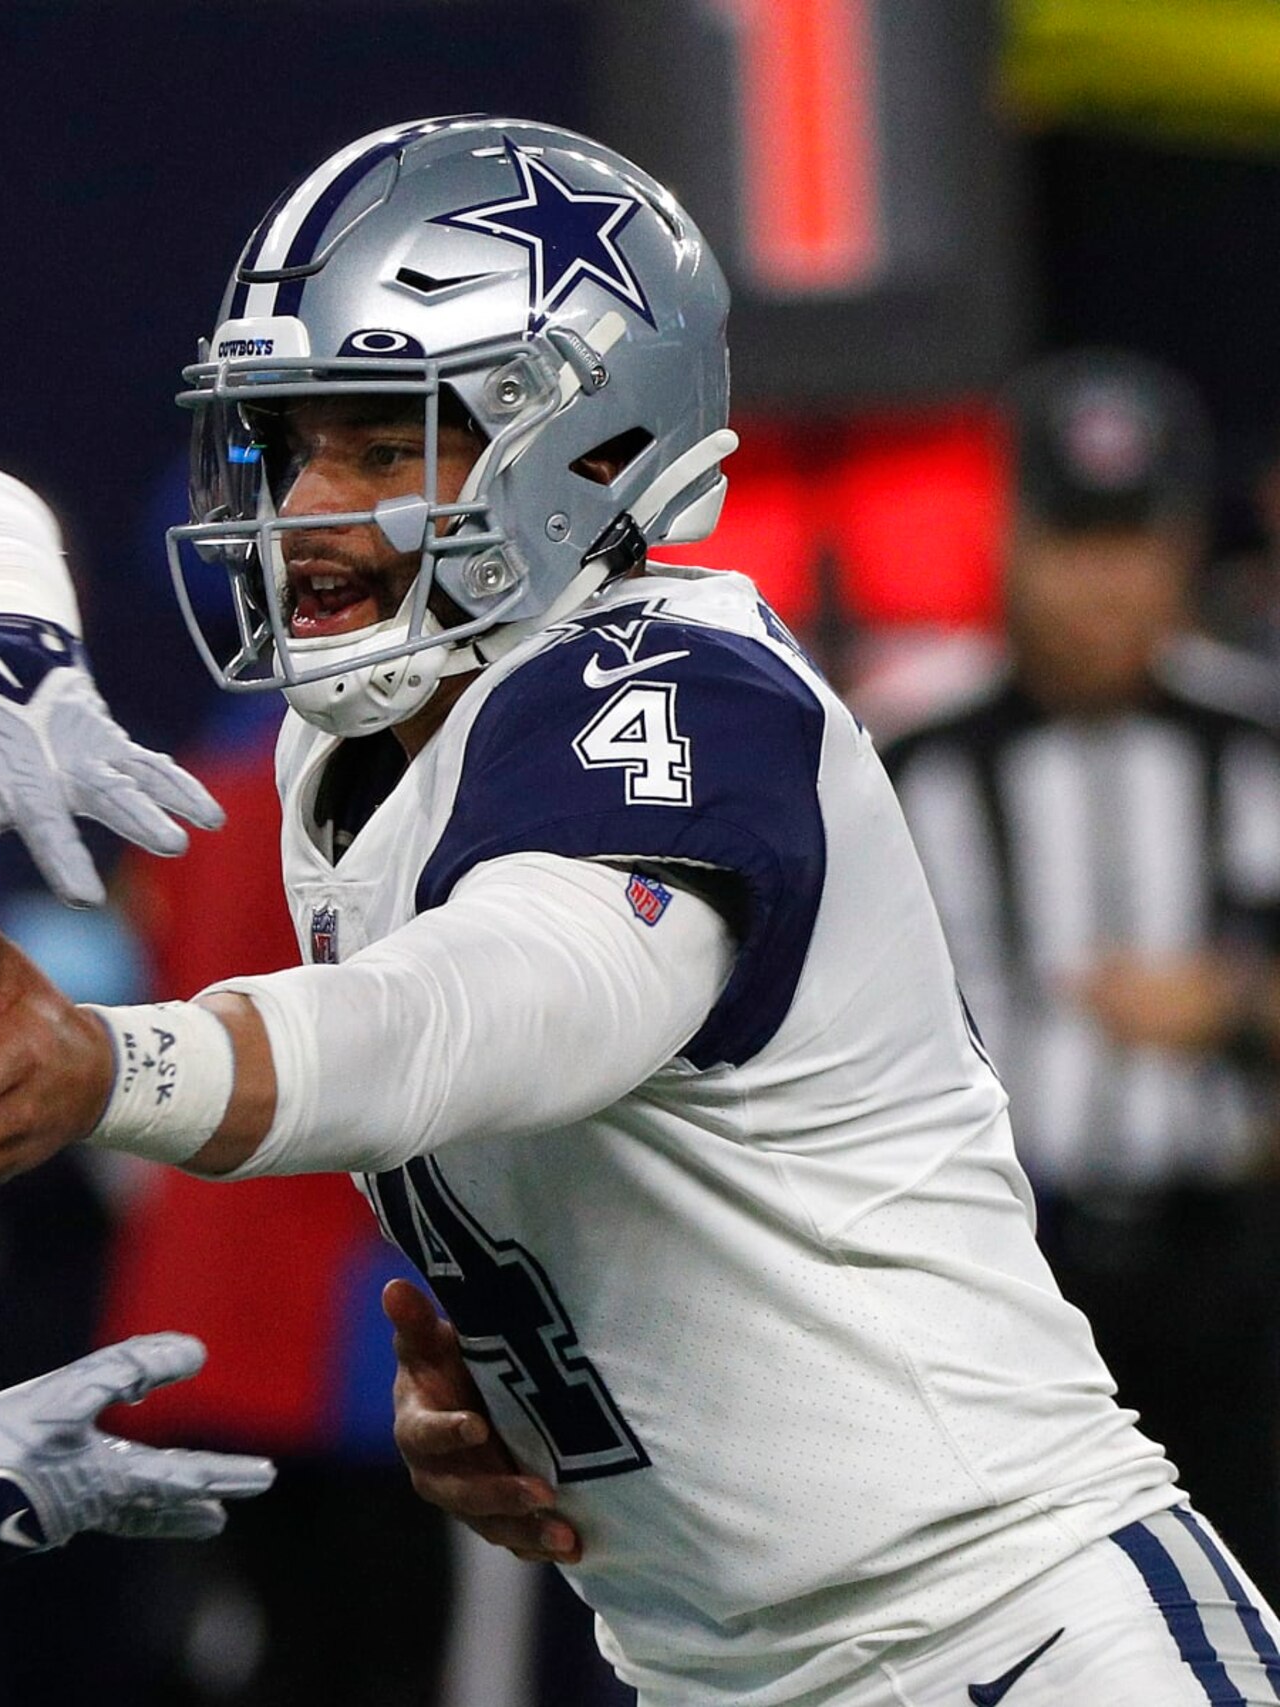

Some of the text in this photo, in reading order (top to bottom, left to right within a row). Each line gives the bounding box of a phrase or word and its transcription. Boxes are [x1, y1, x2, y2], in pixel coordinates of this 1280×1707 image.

[218, 339, 274, 358] COWBOYS
[571, 680, 692, 807] 4
[629, 880, 660, 922] NFL
[150, 1026, 176, 1106] ASK
[362, 1153, 652, 1485] 4
